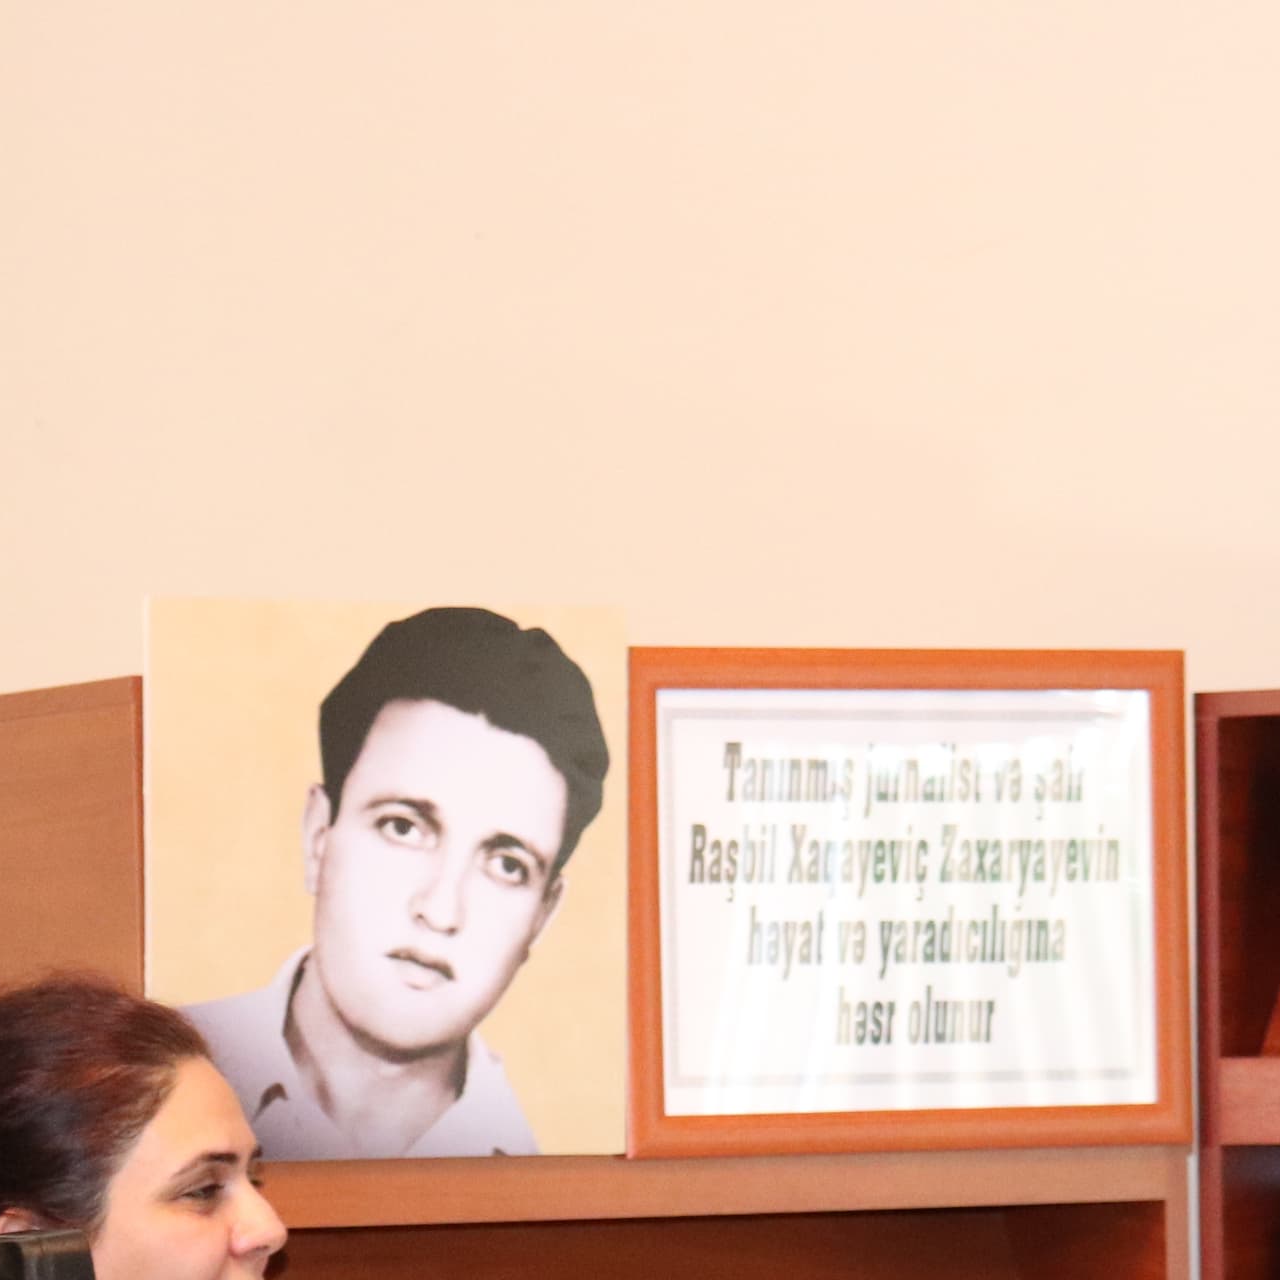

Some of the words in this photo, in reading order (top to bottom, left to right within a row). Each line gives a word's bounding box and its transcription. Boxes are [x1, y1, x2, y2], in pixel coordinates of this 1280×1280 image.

[688, 823, 777, 901] Raşbil
[747, 904, 824, 980] həyat
[837, 919, 866, 965] və
[835, 985, 896, 1046] həsr
[907, 985, 996, 1045] olunur
